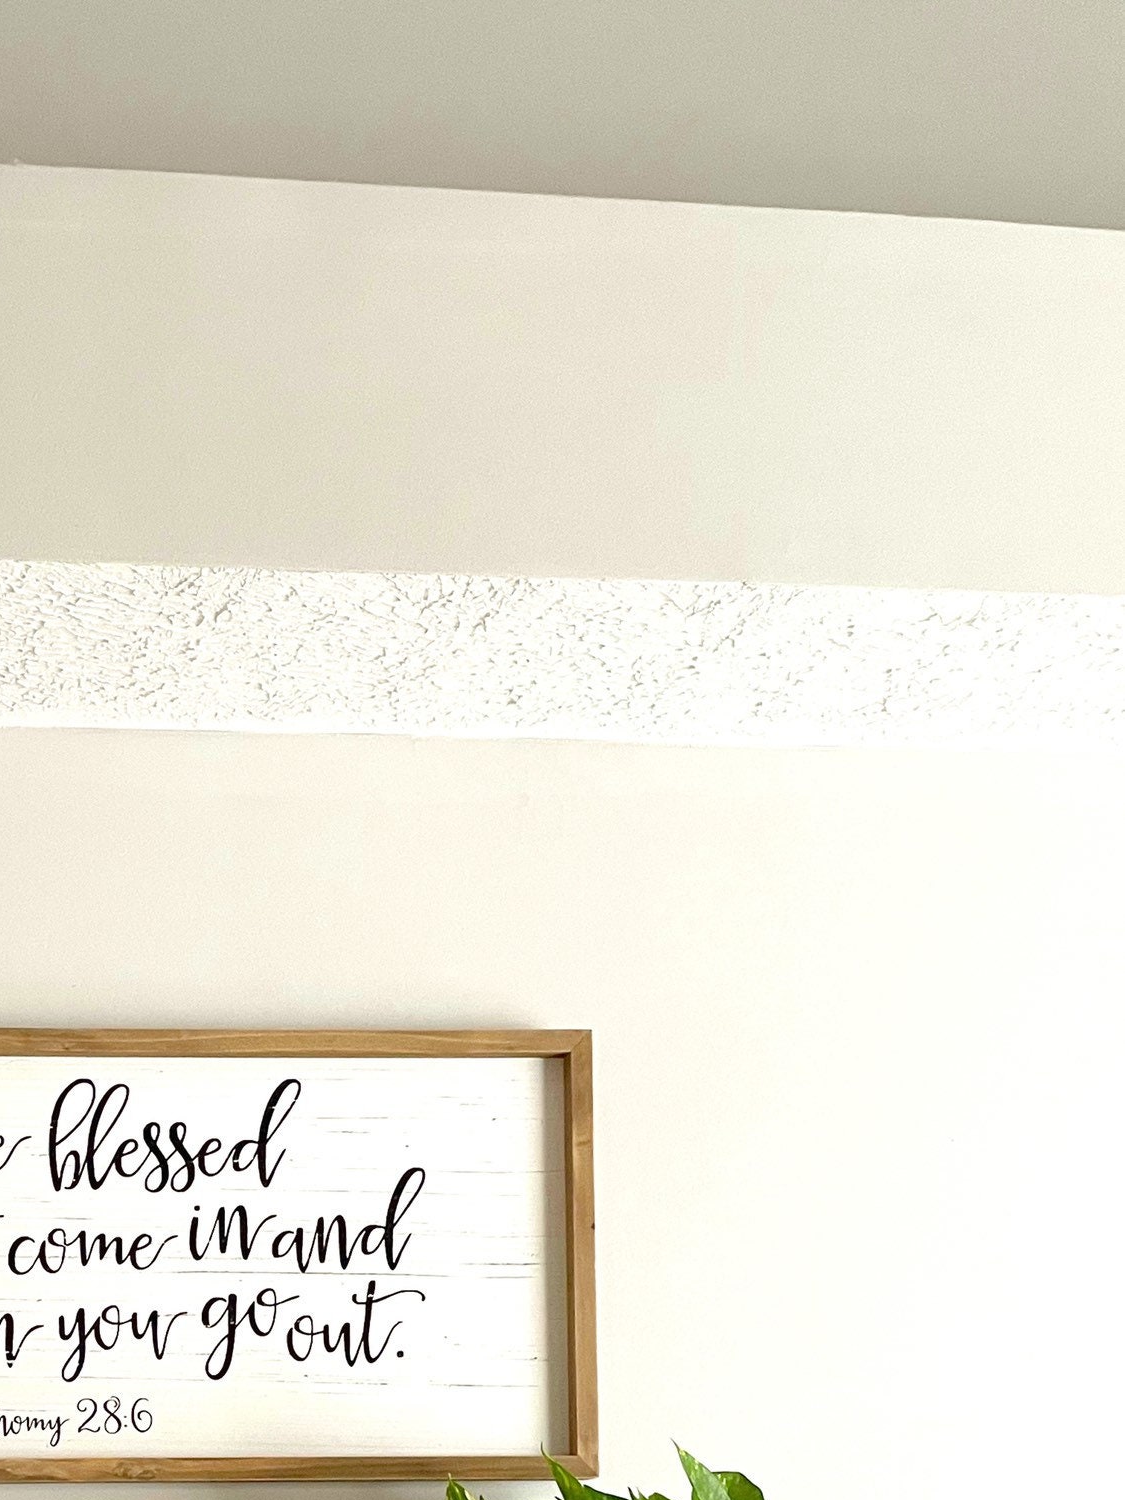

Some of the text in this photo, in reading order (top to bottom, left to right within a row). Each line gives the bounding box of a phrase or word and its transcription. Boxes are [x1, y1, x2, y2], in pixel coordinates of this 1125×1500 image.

[48, 1078, 302, 1193] blessed
[7, 1228, 179, 1276] come
[188, 1204, 278, 1261] in
[271, 1167, 426, 1274] and
[58, 1304, 188, 1383] you
[201, 1287, 300, 1381] go
[286, 1280, 426, 1368] out.
[76, 1395, 153, 1435] 28:6
